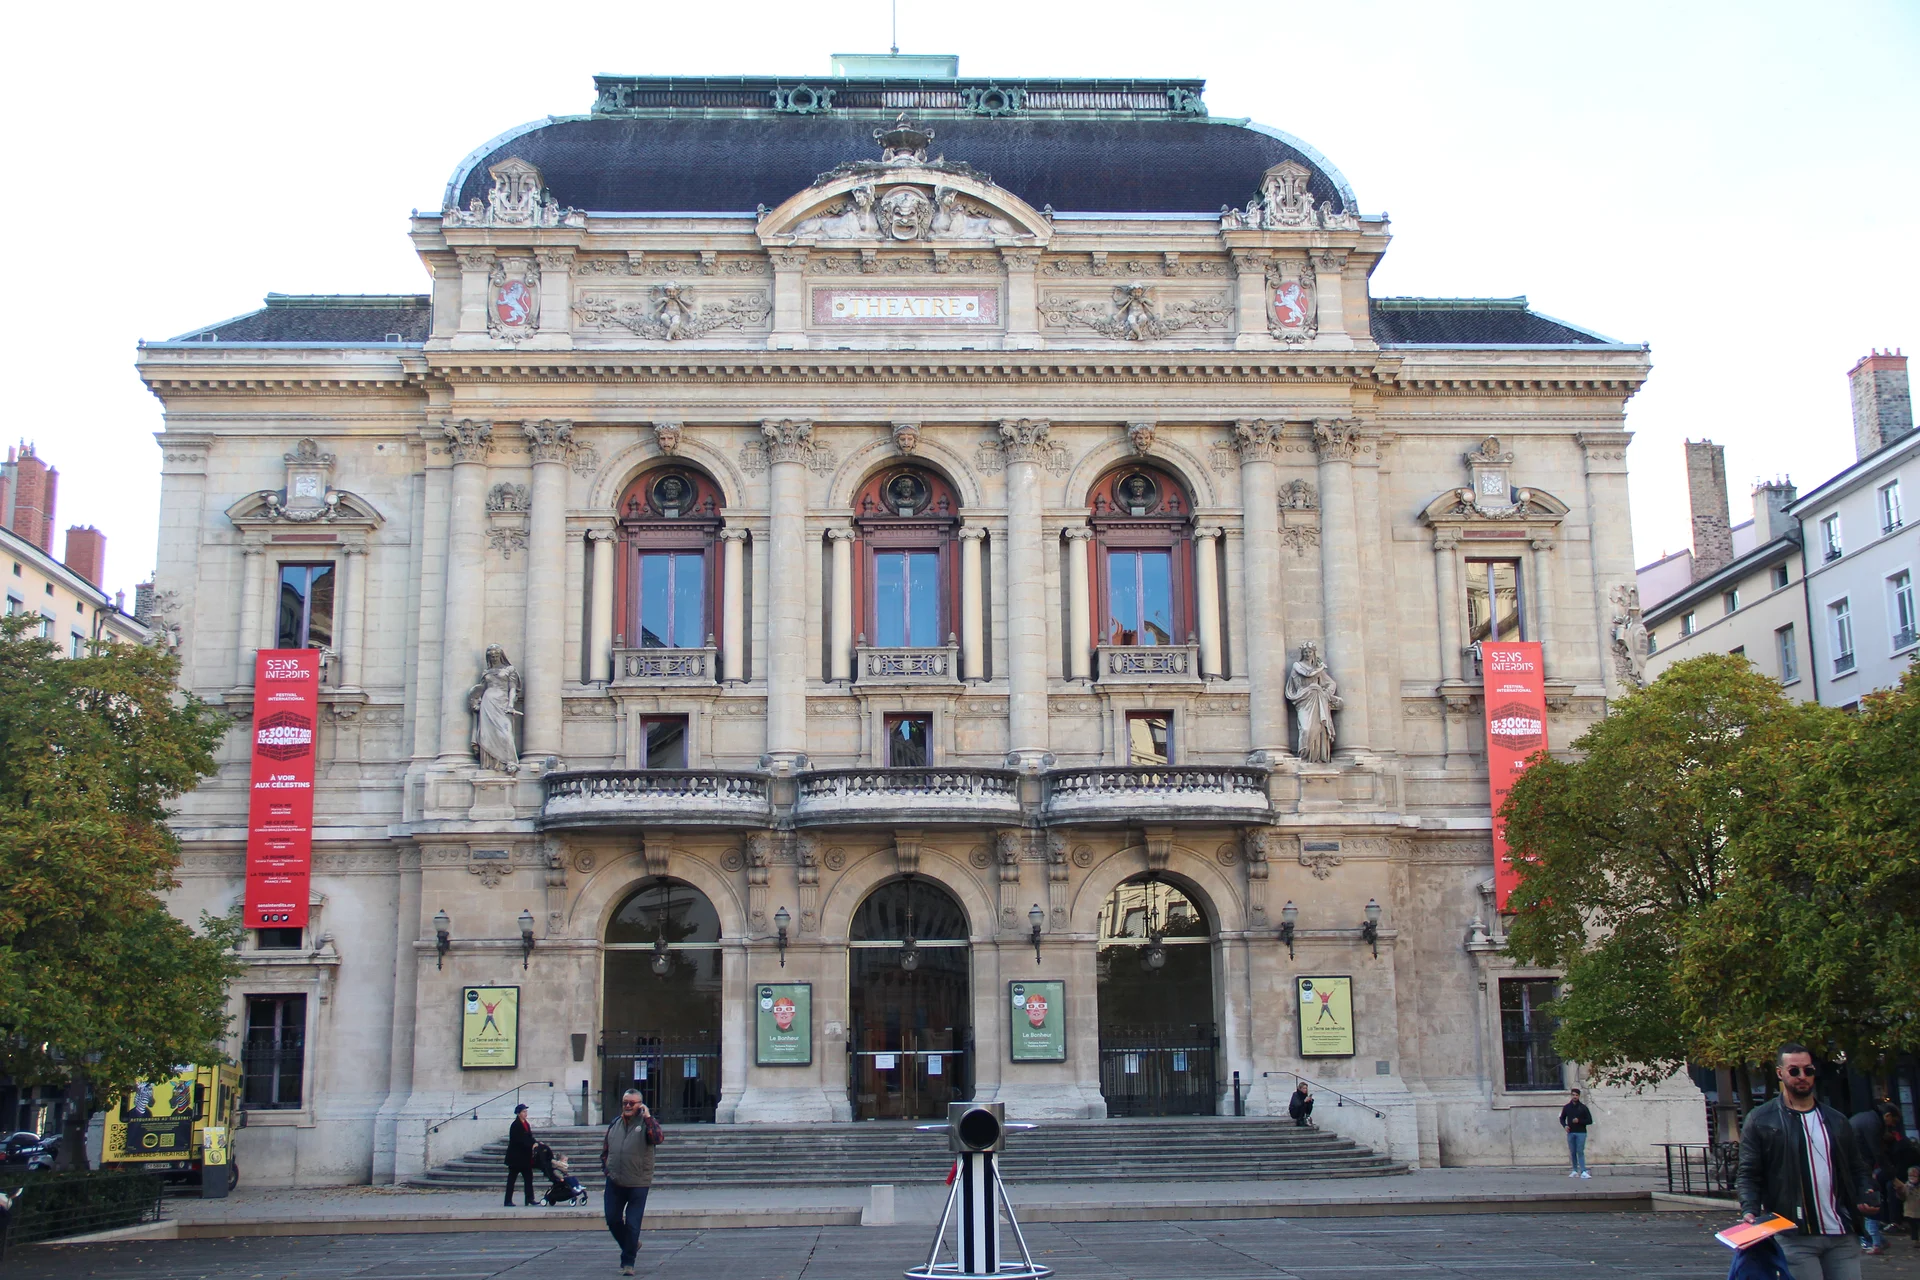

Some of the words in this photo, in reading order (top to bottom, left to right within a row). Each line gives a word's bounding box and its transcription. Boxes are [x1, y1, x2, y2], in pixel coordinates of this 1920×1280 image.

[849, 297, 963, 316] THEATRE
[1491, 651, 1522, 662] SENS
[266, 659, 299, 670] SENS
[1491, 662, 1534, 671] INTERDITS
[265, 670, 310, 679] INTERDITS
[1490, 717, 1515, 729] 13-30
[1515, 717, 1529, 729] OCT
[258, 726, 284, 738] 13-30
[284, 726, 300, 738] OCT
[299, 728, 312, 738] 2021
[1490, 727, 1515, 736] LYON
[257, 737, 284, 745] LYON
